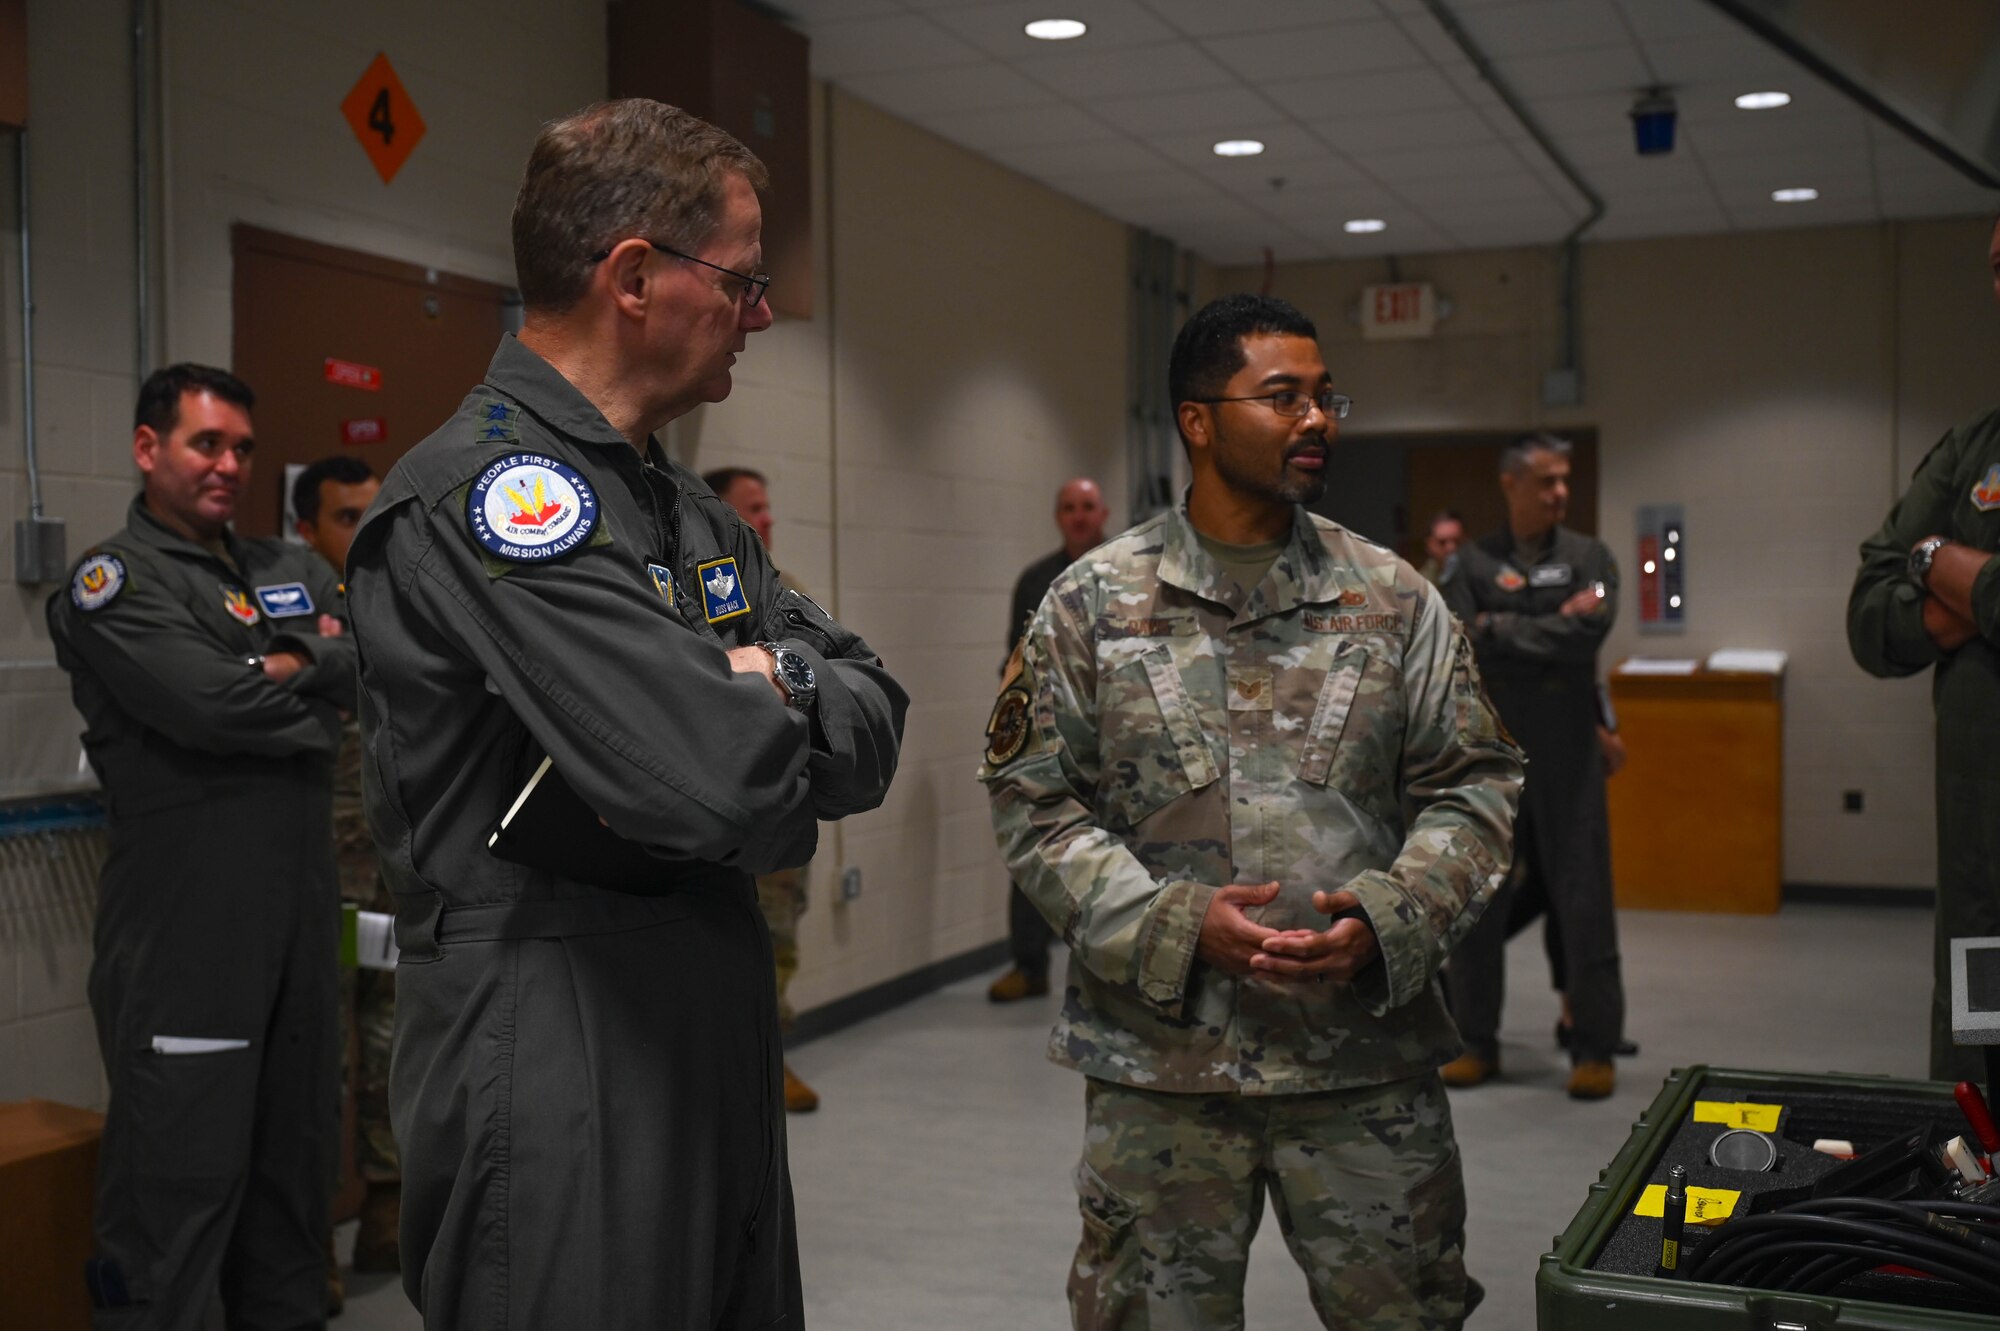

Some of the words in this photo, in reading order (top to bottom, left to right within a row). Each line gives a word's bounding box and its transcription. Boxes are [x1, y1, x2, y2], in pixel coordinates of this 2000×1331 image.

[368, 87, 395, 146] 4
[1375, 288, 1420, 323] EXIT
[476, 456, 519, 491] PEOPLE
[522, 455, 560, 469] FIRST
[498, 543, 552, 558] MISSION
[553, 518, 592, 554] ALWAYS
[505, 525, 519, 534] AIR
[715, 603, 727, 616] RUSS
[1330, 615, 1353, 631] AIR
